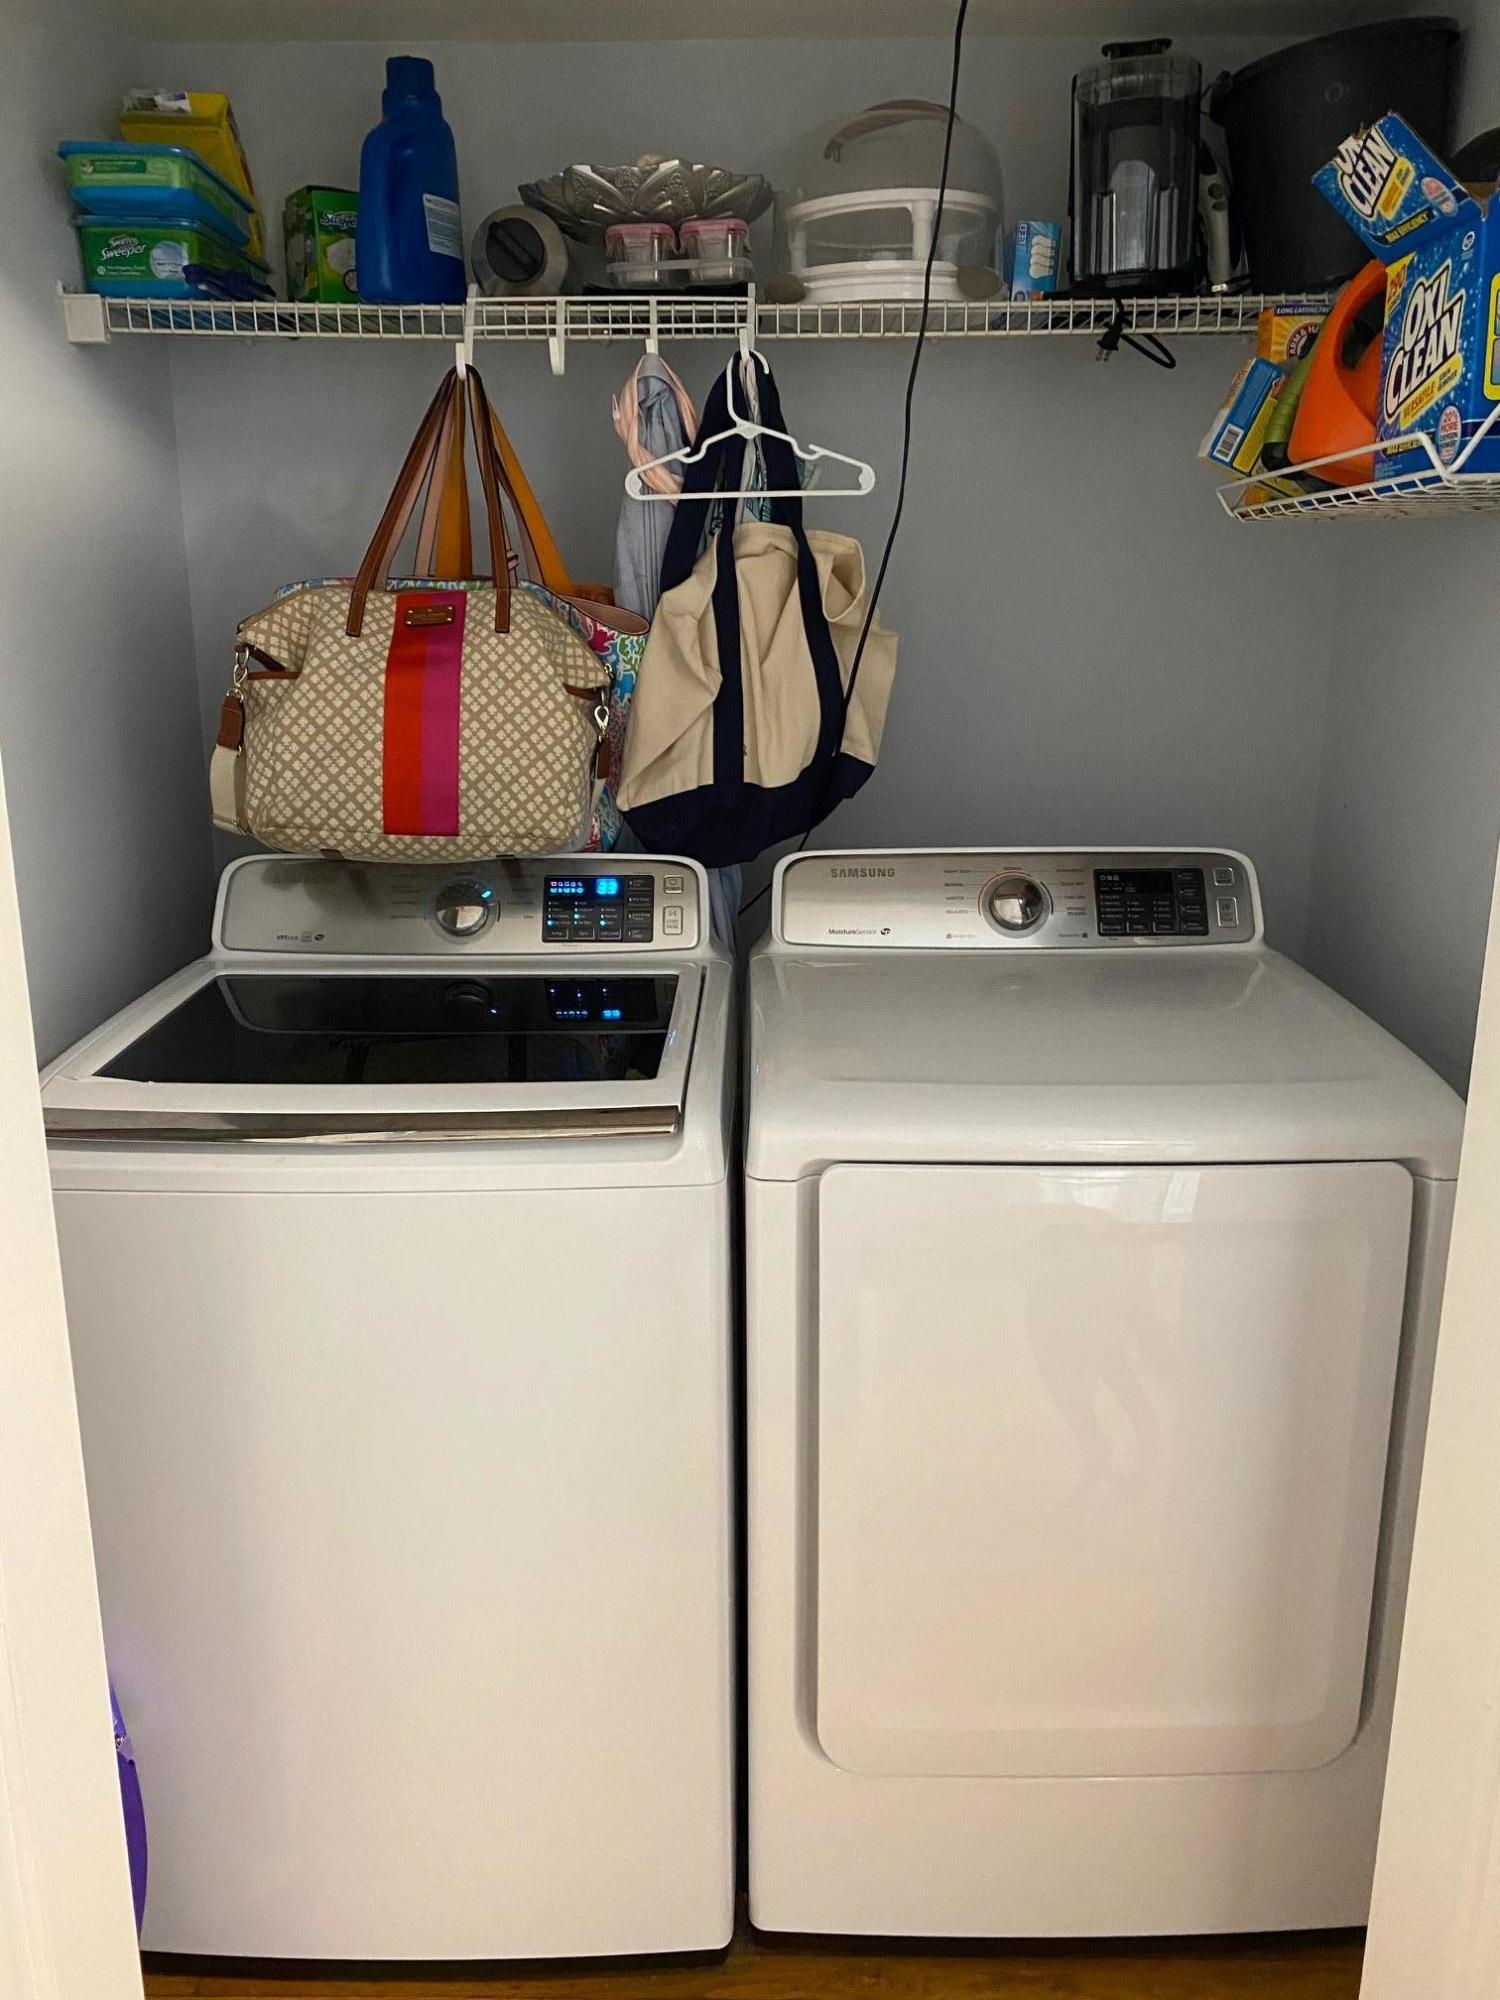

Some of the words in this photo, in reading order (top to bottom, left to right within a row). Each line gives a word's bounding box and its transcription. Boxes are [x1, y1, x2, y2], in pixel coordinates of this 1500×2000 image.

[1341, 125, 1396, 217] CLEAN
[100, 244, 147, 261] Sweeper
[1018, 223, 1028, 246] LED
[1402, 267, 1449, 352] OXI
[1386, 299, 1462, 419] CLEAN
[830, 867, 896, 879] SAMSUNG
